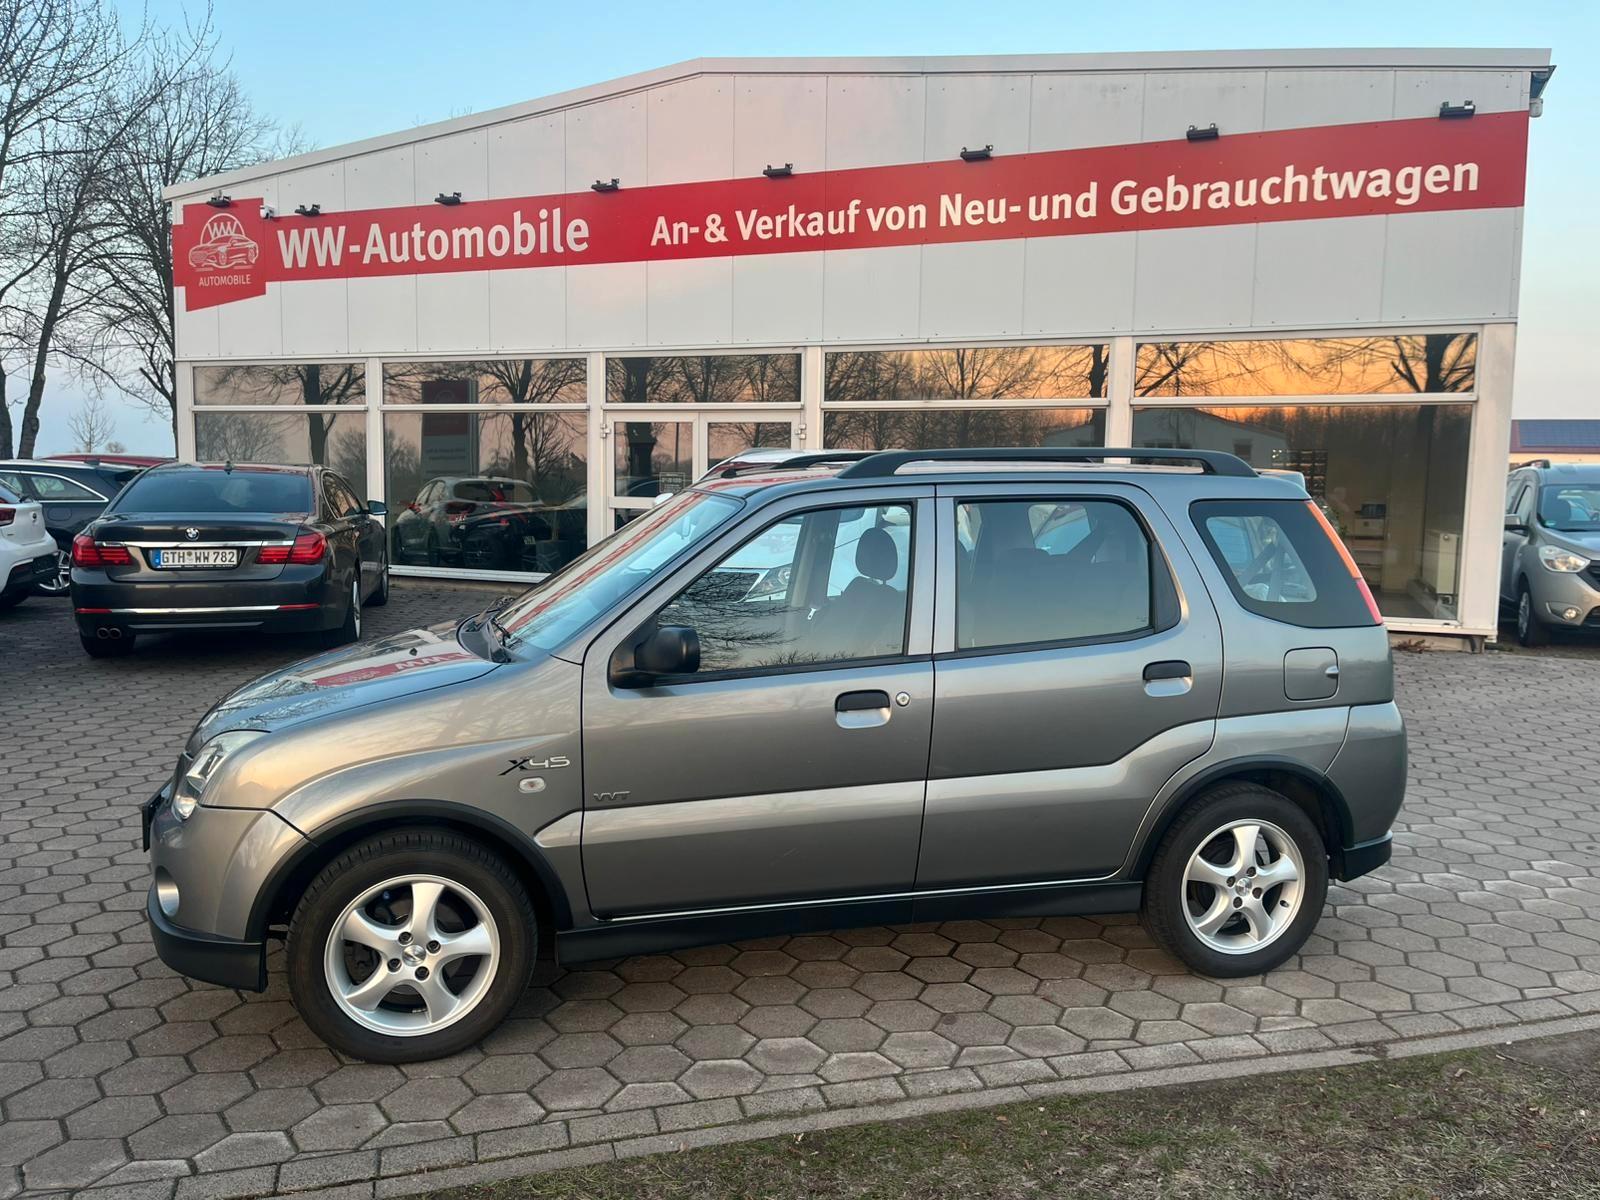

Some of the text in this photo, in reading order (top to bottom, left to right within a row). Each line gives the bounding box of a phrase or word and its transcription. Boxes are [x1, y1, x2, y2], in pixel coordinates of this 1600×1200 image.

[650, 162, 1479, 247] An- & Verkauf von Neu- und Gebrauchtwagen
[276, 207, 590, 269] WW-Automobile
[198, 274, 252, 287] AUTOMOBILE
[161, 551, 235, 563] GTH WW 782
